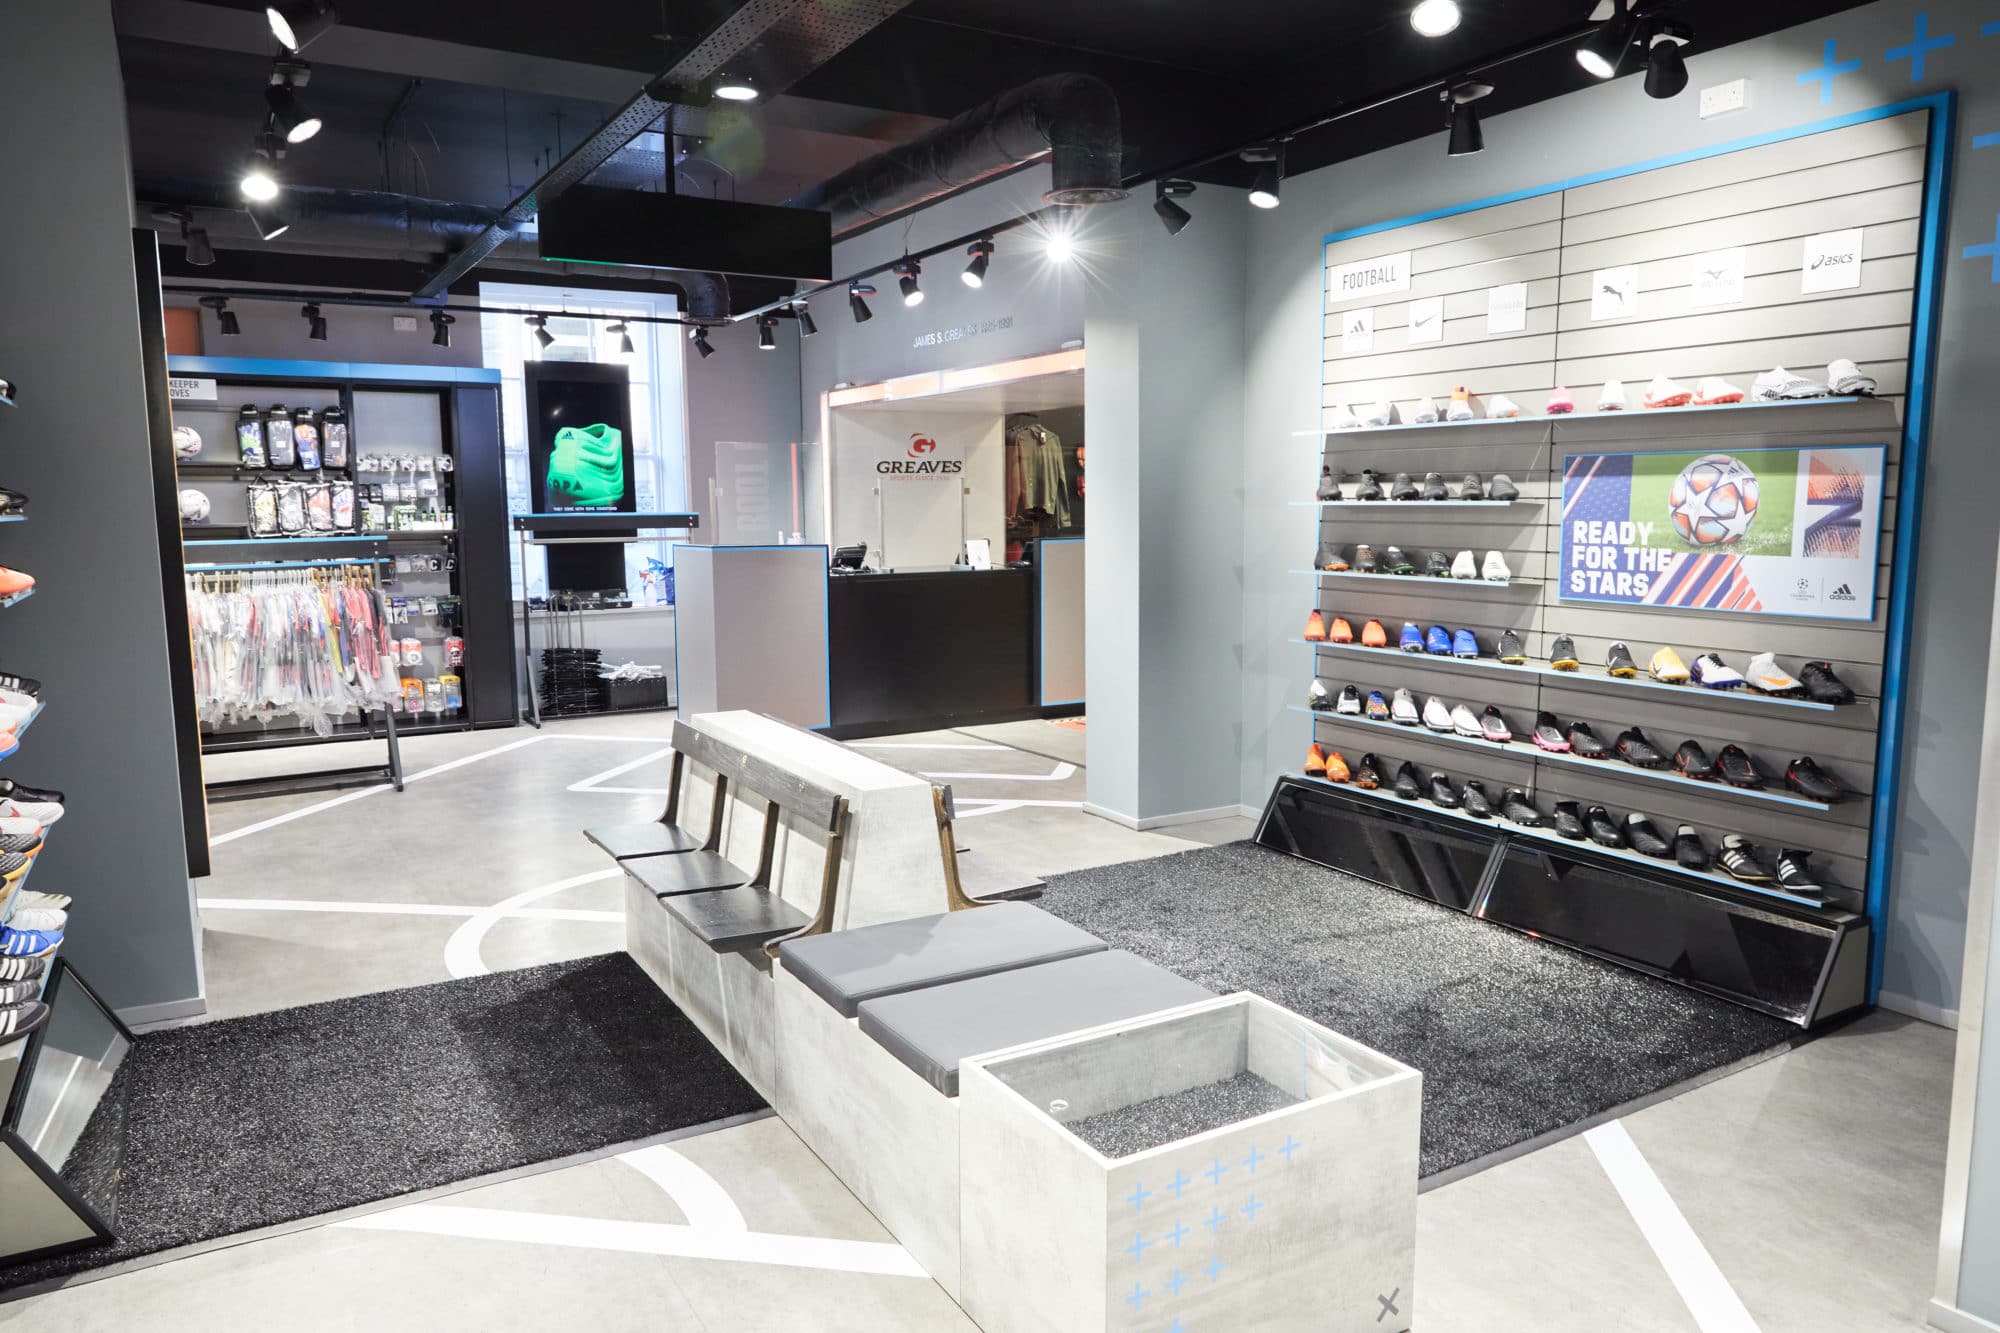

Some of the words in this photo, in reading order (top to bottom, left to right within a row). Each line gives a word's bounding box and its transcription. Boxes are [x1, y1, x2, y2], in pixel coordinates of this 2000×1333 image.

[1825, 253, 1854, 266] asics
[1342, 265, 1397, 291] FOOTBALL
[913, 333, 936, 348] JAMES
[876, 460, 962, 474] GREAVES
[1572, 520, 1654, 546] READY
[1571, 545, 1618, 570] FOR
[1623, 546, 1673, 572] THE
[1570, 569, 1650, 598] STARS
